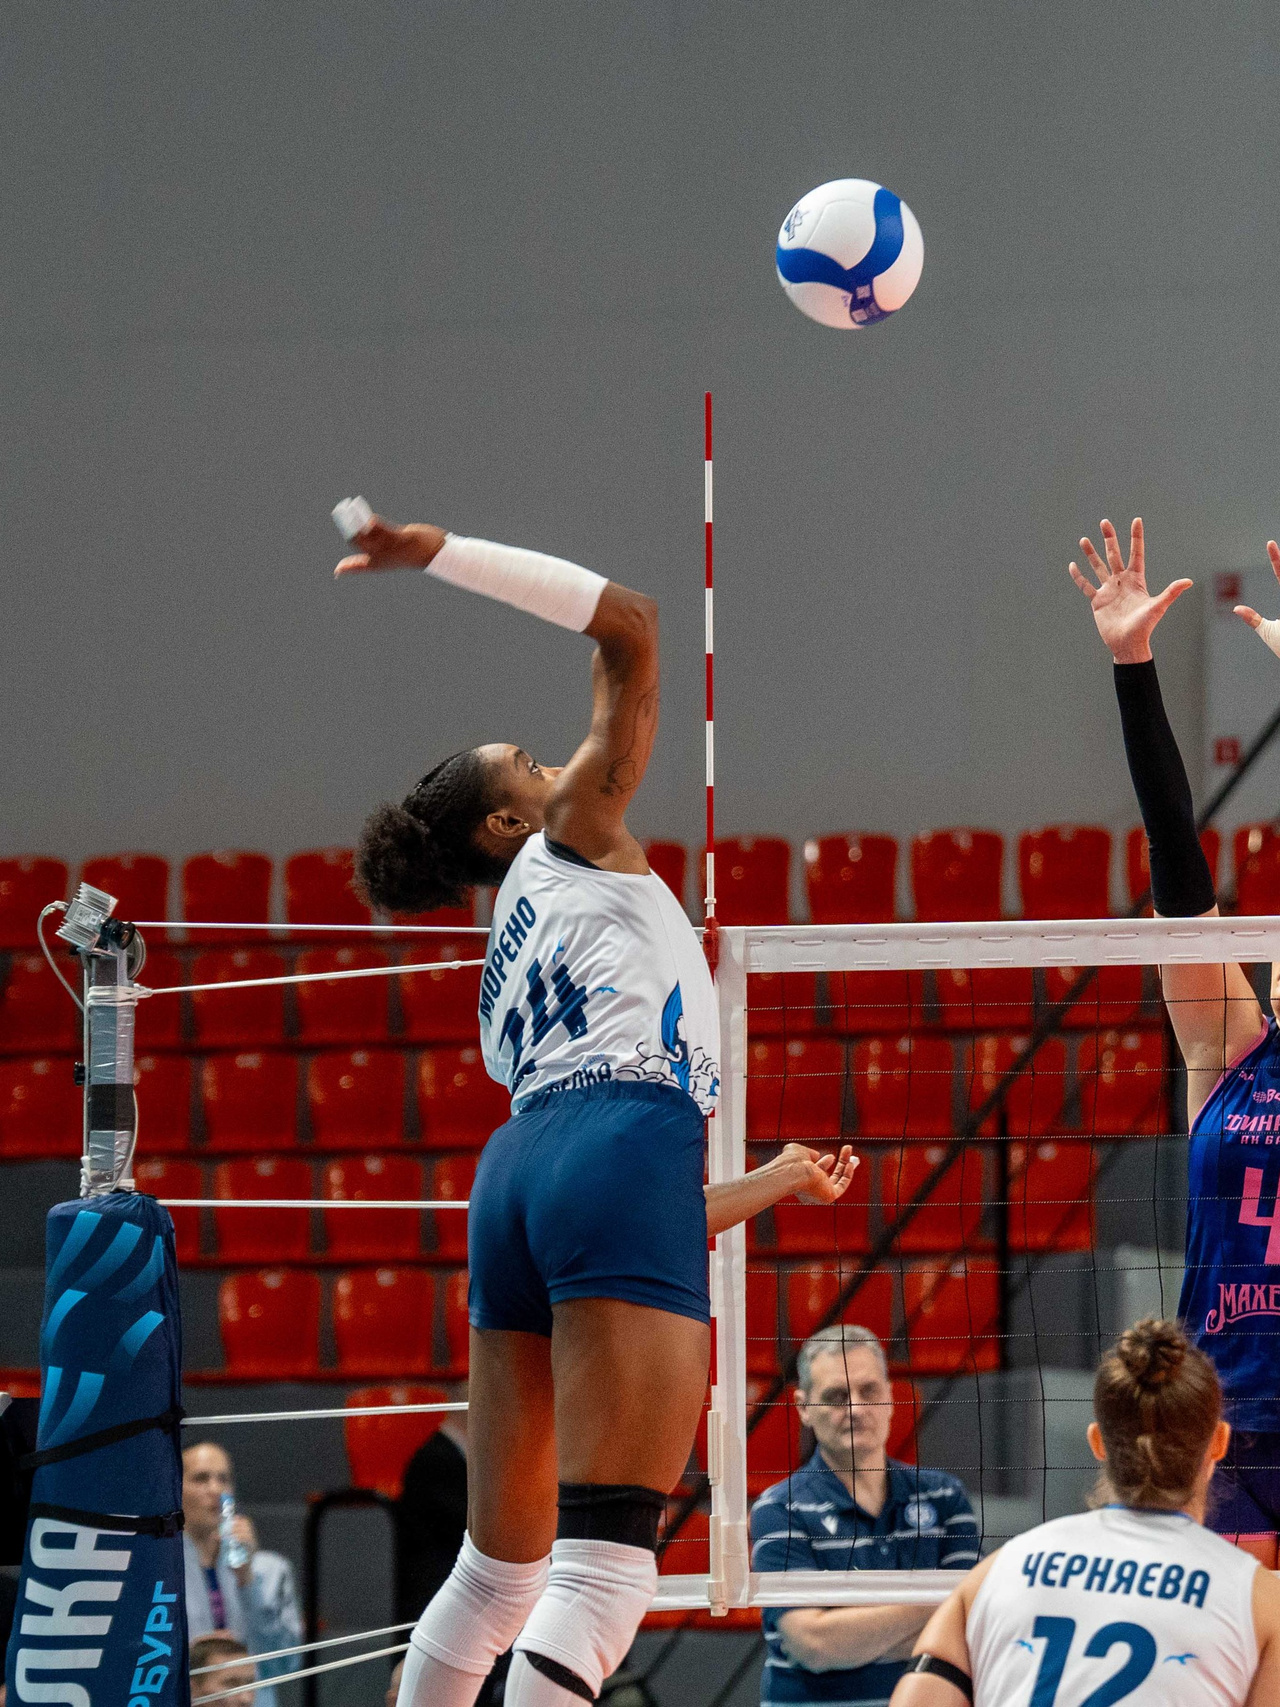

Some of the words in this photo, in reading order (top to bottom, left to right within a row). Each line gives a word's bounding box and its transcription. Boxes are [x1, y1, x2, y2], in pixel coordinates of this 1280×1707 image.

[478, 895, 537, 1025] МОРЕНО
[1021, 1551, 1211, 1609] ЧЕРНЯЕВА
[1028, 1615, 1158, 1707] 12
